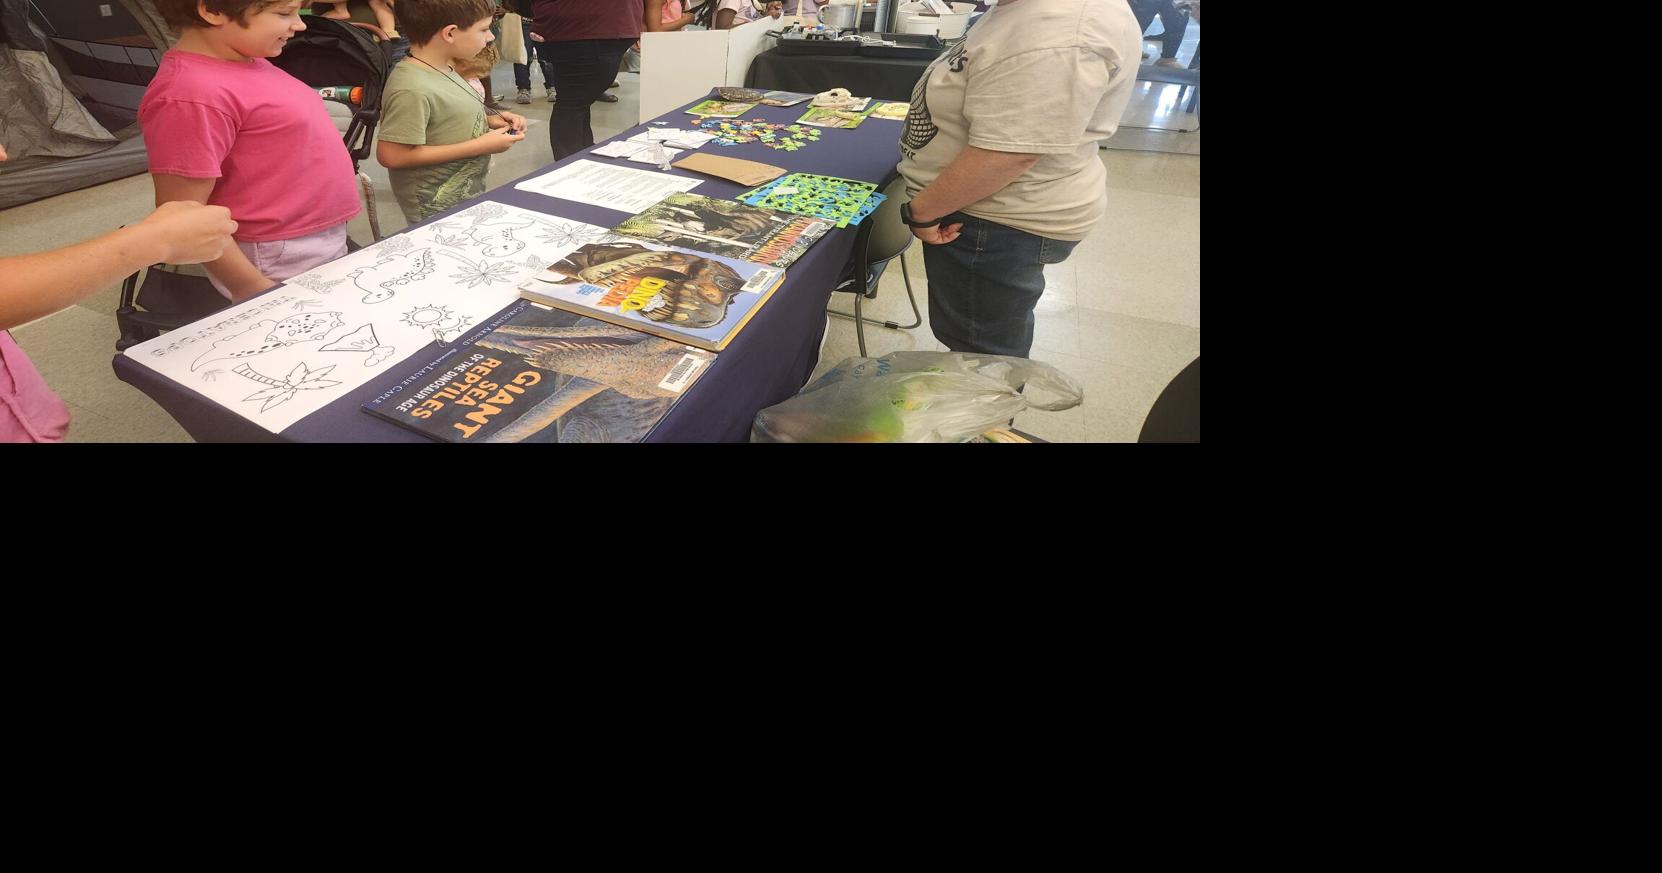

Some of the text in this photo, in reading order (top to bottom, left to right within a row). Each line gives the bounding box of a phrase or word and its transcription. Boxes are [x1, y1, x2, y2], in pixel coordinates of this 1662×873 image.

[395, 353, 485, 413] OF THE DINOSAUR AGE
[403, 364, 431, 386] LAURIE
[410, 357, 503, 419] REPTILES
[453, 370, 542, 439] GIANT
[454, 380, 499, 407] SEA
